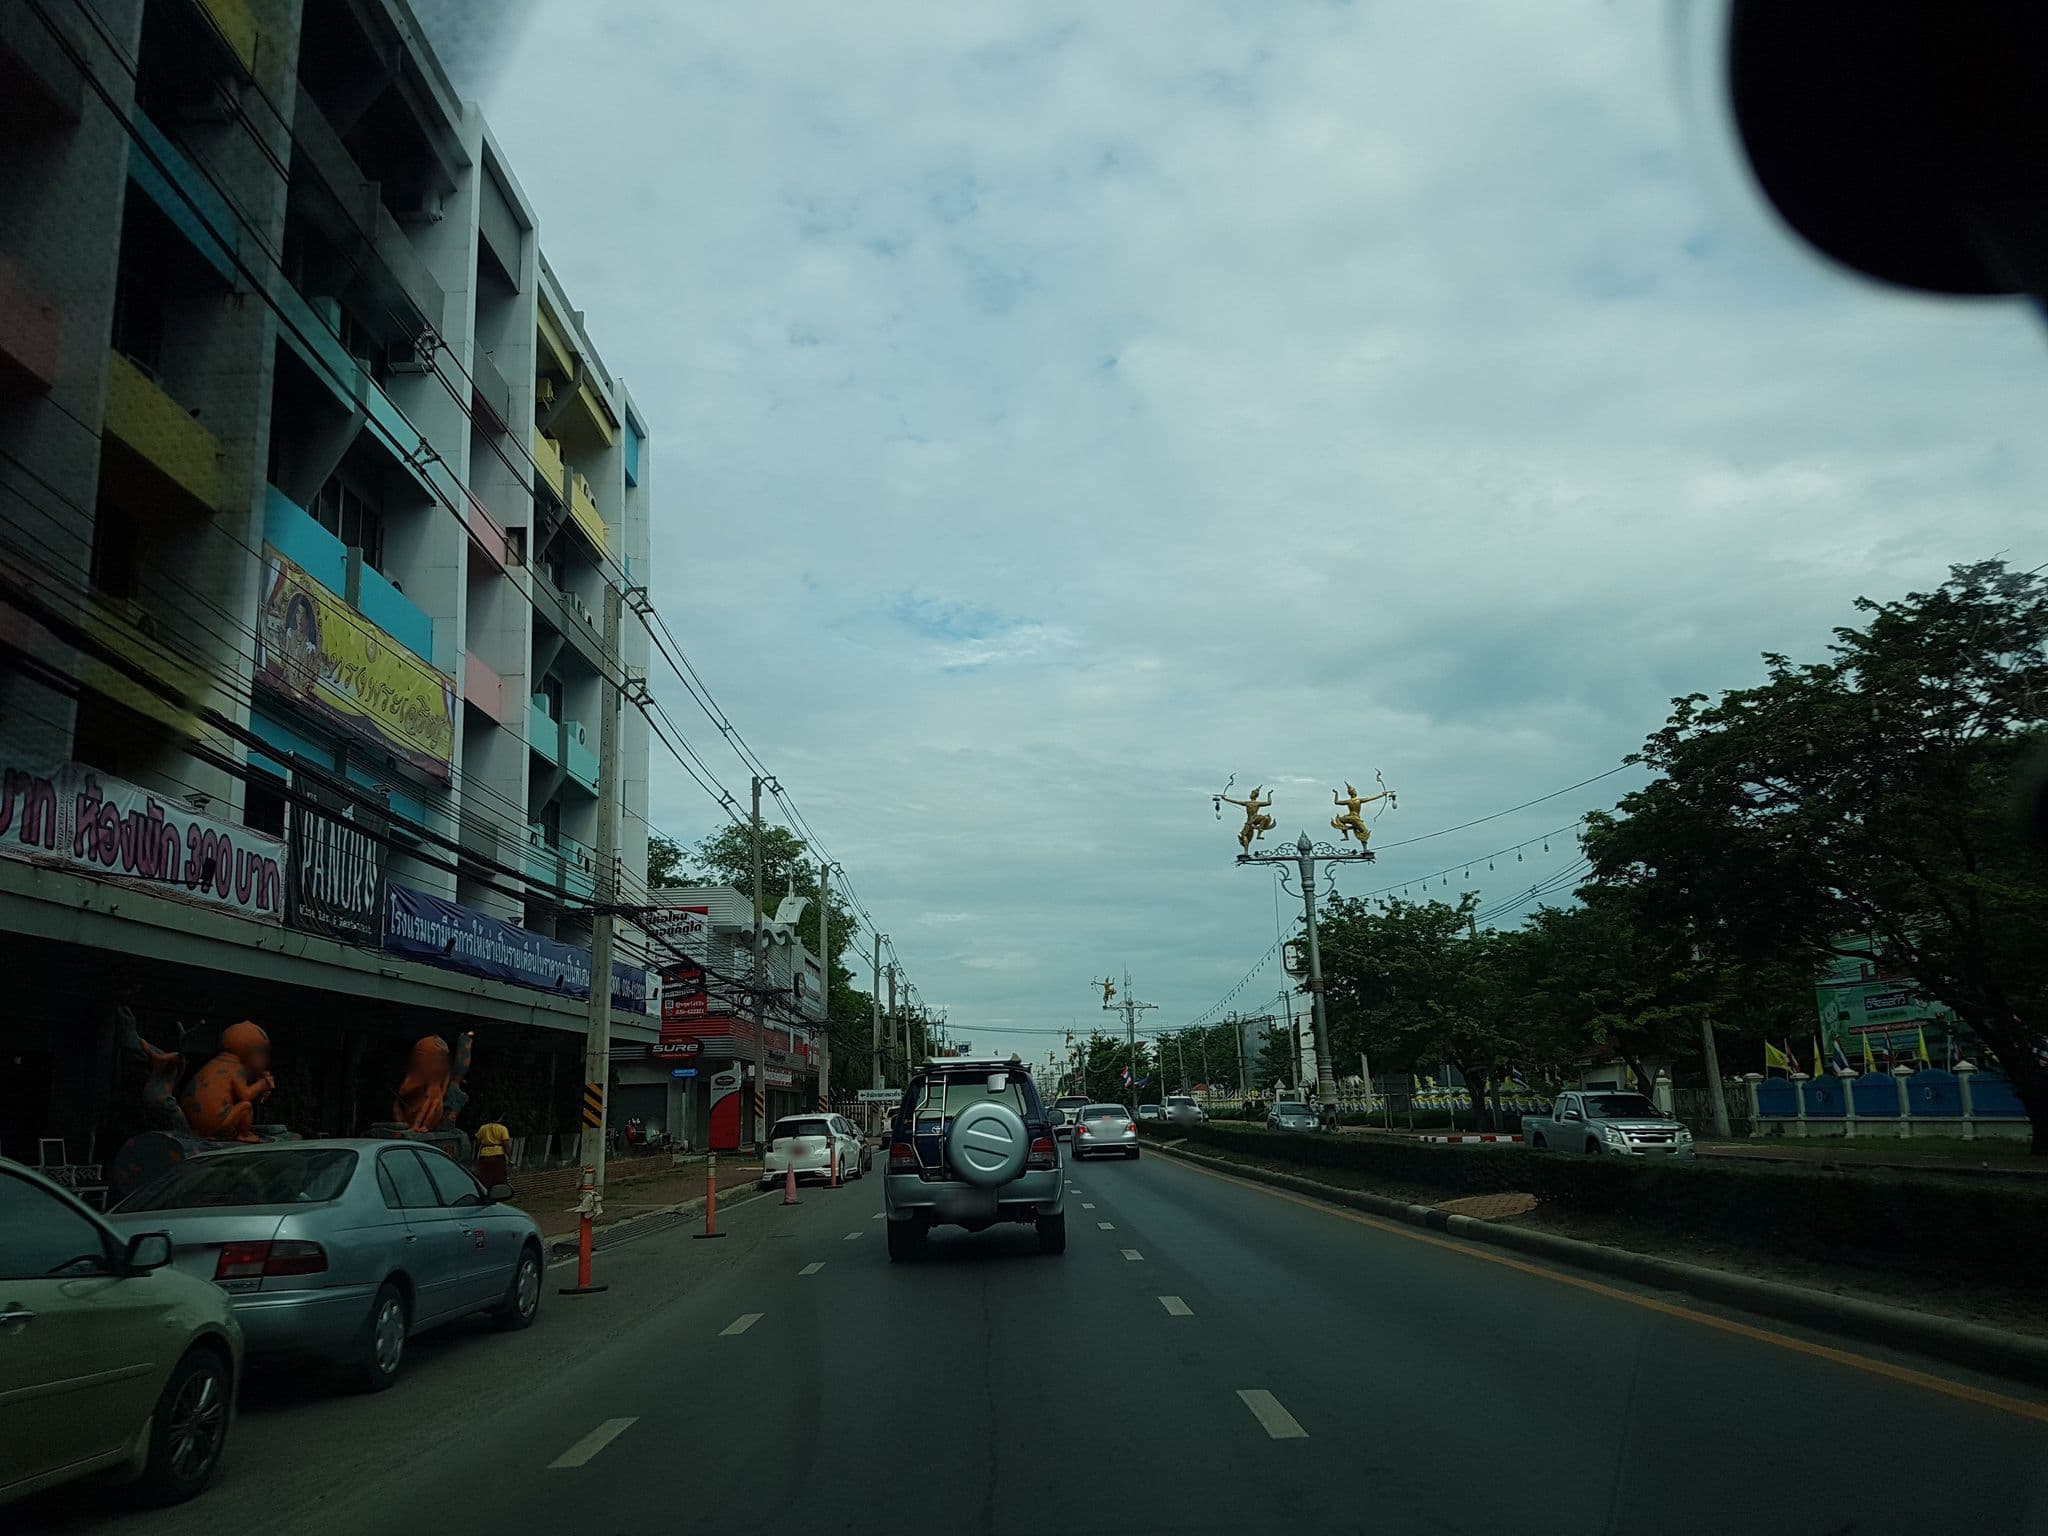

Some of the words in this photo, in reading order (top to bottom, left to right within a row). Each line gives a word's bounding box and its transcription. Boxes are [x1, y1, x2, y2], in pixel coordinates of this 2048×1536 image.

[74, 773, 181, 884] ห้องพัก
[185, 822, 233, 900] 300
[235, 847, 280, 913] บาท
[651, 1043, 699, 1053] SURE
